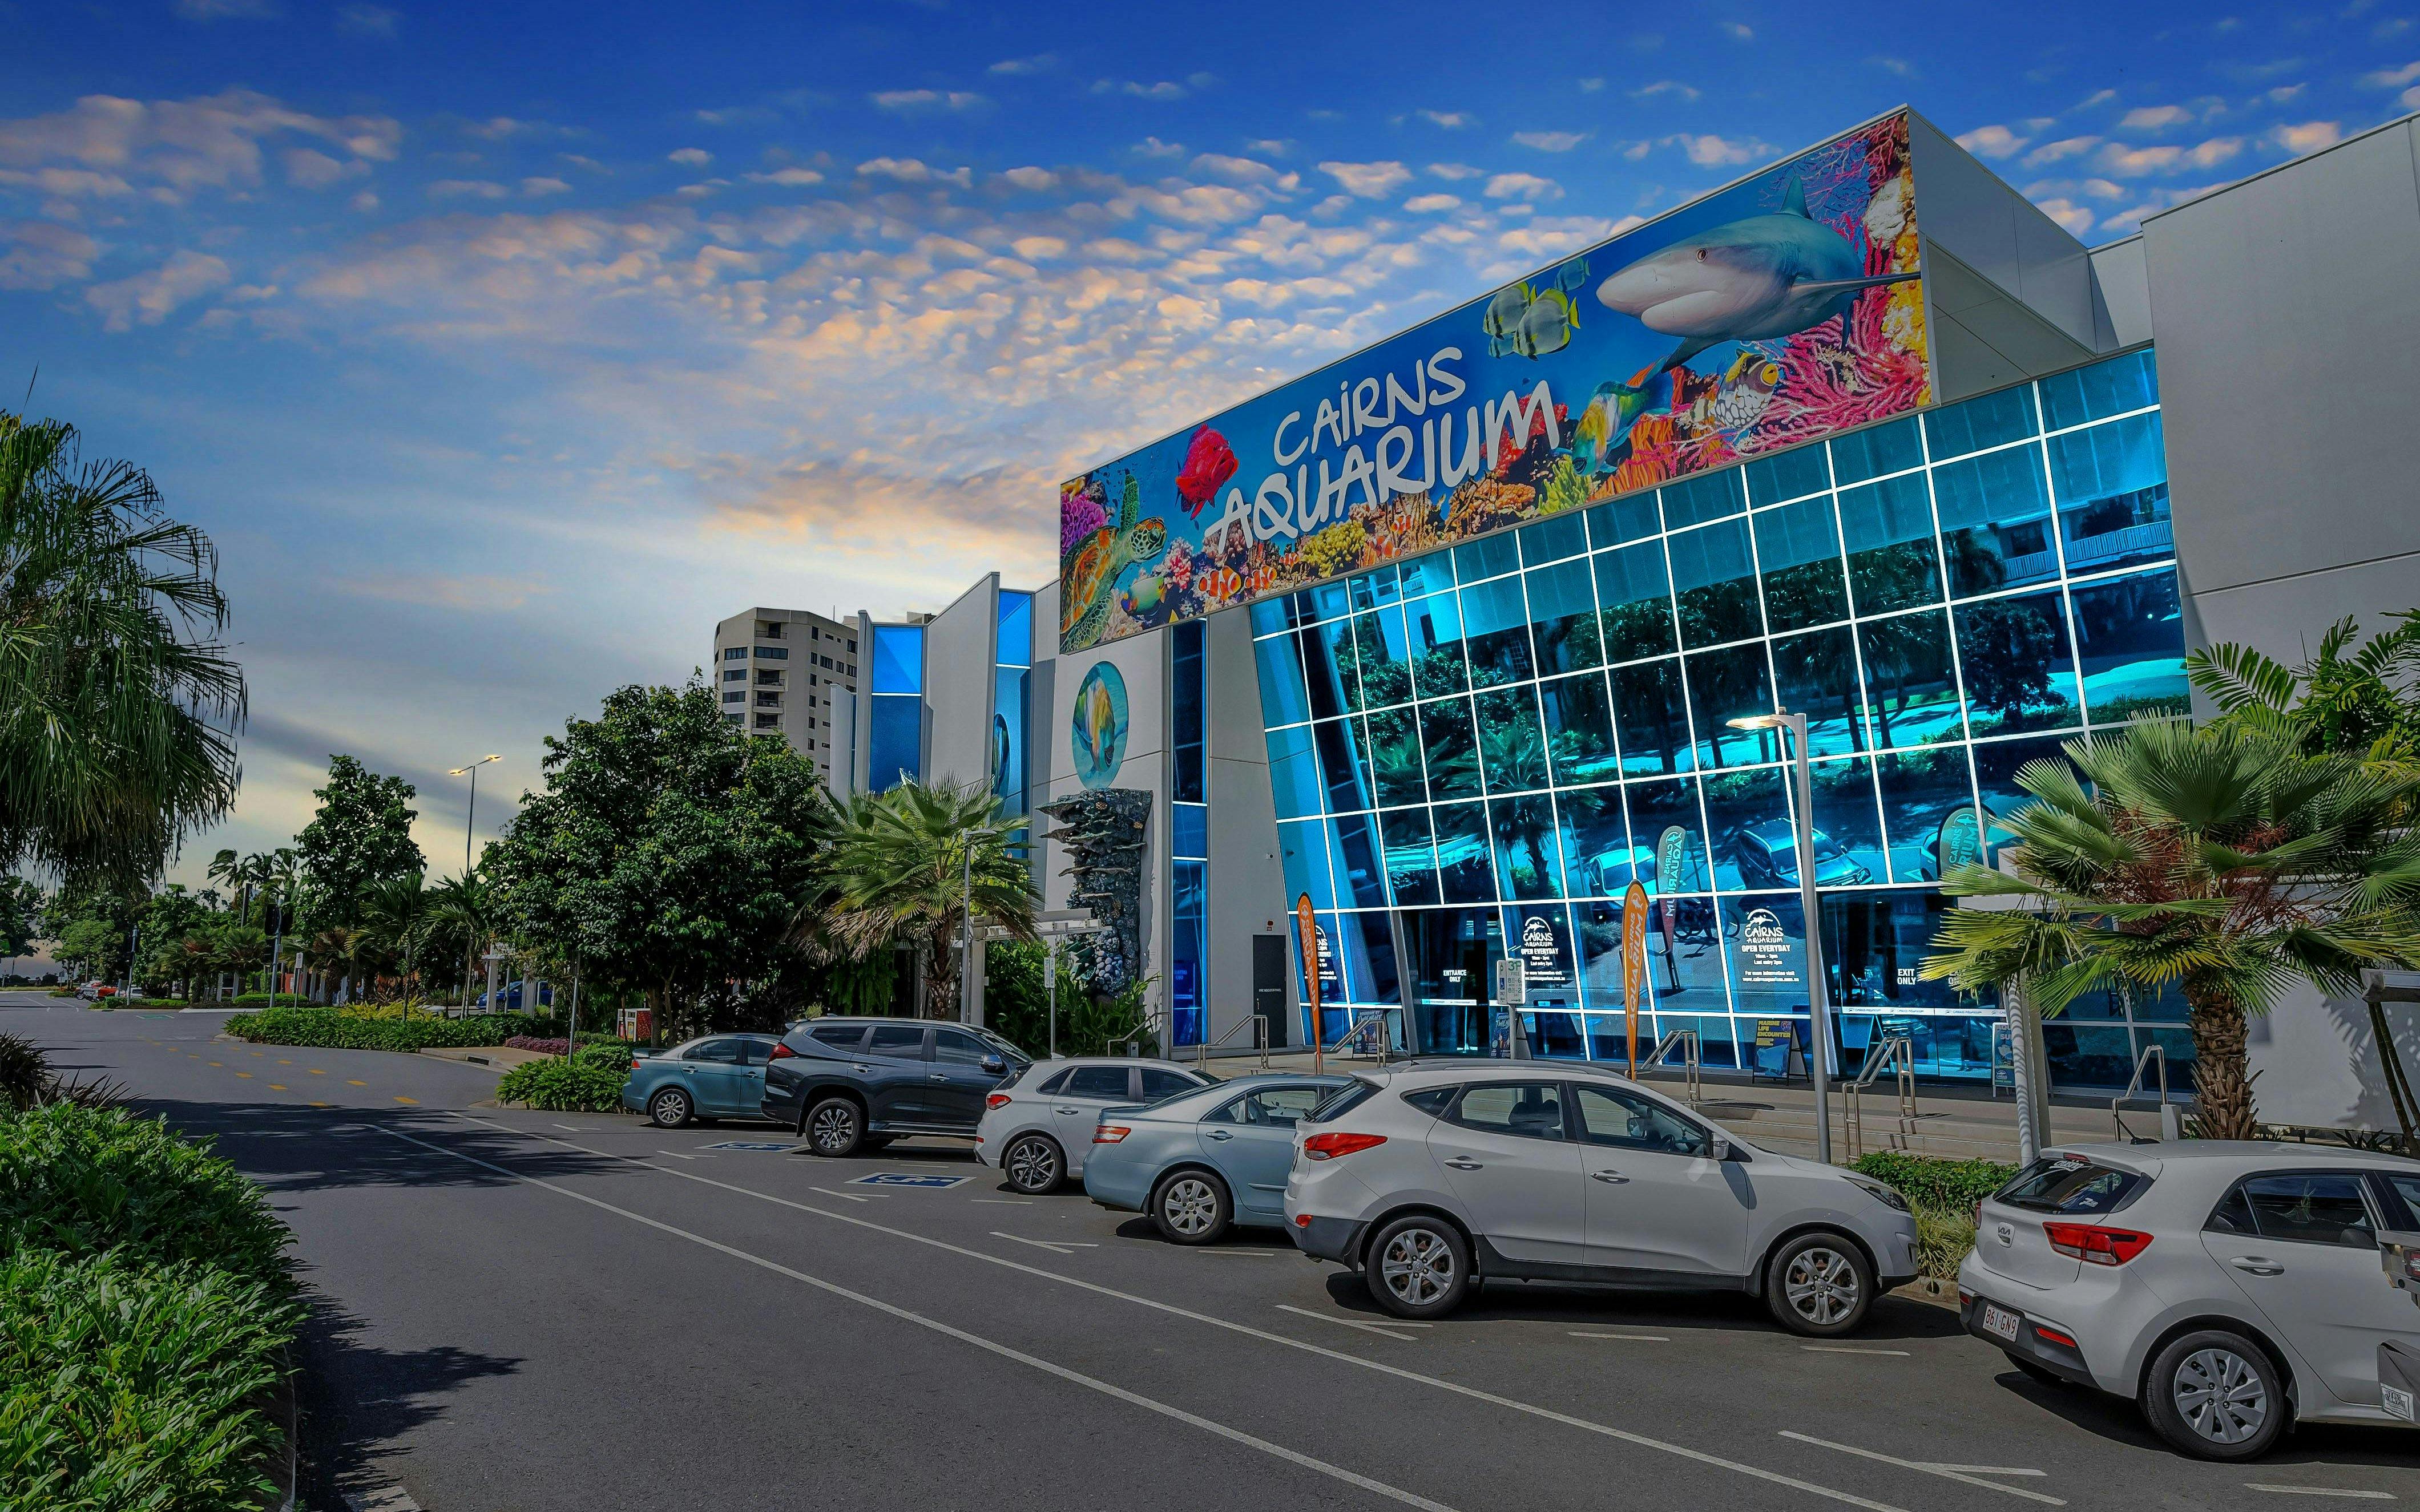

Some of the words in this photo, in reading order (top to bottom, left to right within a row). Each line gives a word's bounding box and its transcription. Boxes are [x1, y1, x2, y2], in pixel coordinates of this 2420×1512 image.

[1204, 379, 1559, 554] AQUARIUM
[1949, 828, 1963, 864] CAIRNS
[1301, 919, 1317, 1011] AQUARIUM
[1629, 913, 1643, 1027] AQUARIUM
[1898, 968, 1915, 977] EXIT
